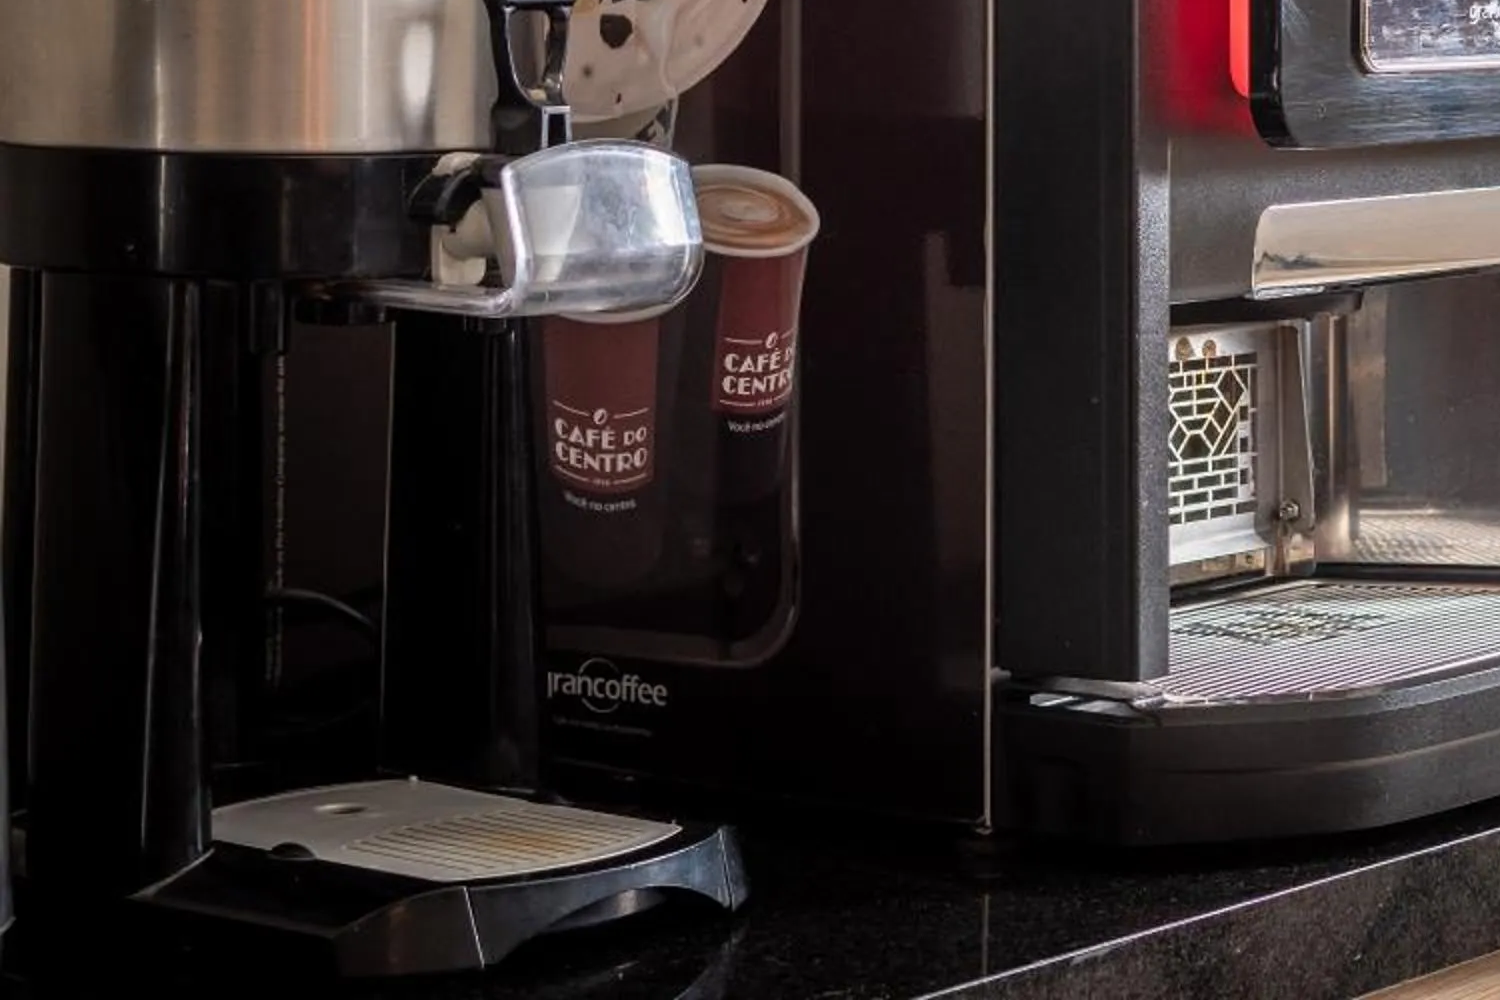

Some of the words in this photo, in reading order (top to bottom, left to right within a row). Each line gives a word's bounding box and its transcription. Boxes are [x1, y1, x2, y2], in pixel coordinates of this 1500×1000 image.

[724, 347, 781, 373] CAFÉ
[722, 368, 792, 396] CENTR
[554, 416, 616, 450] CAFÉ
[622, 426, 648, 447] DO
[555, 440, 648, 473] CENTRO
